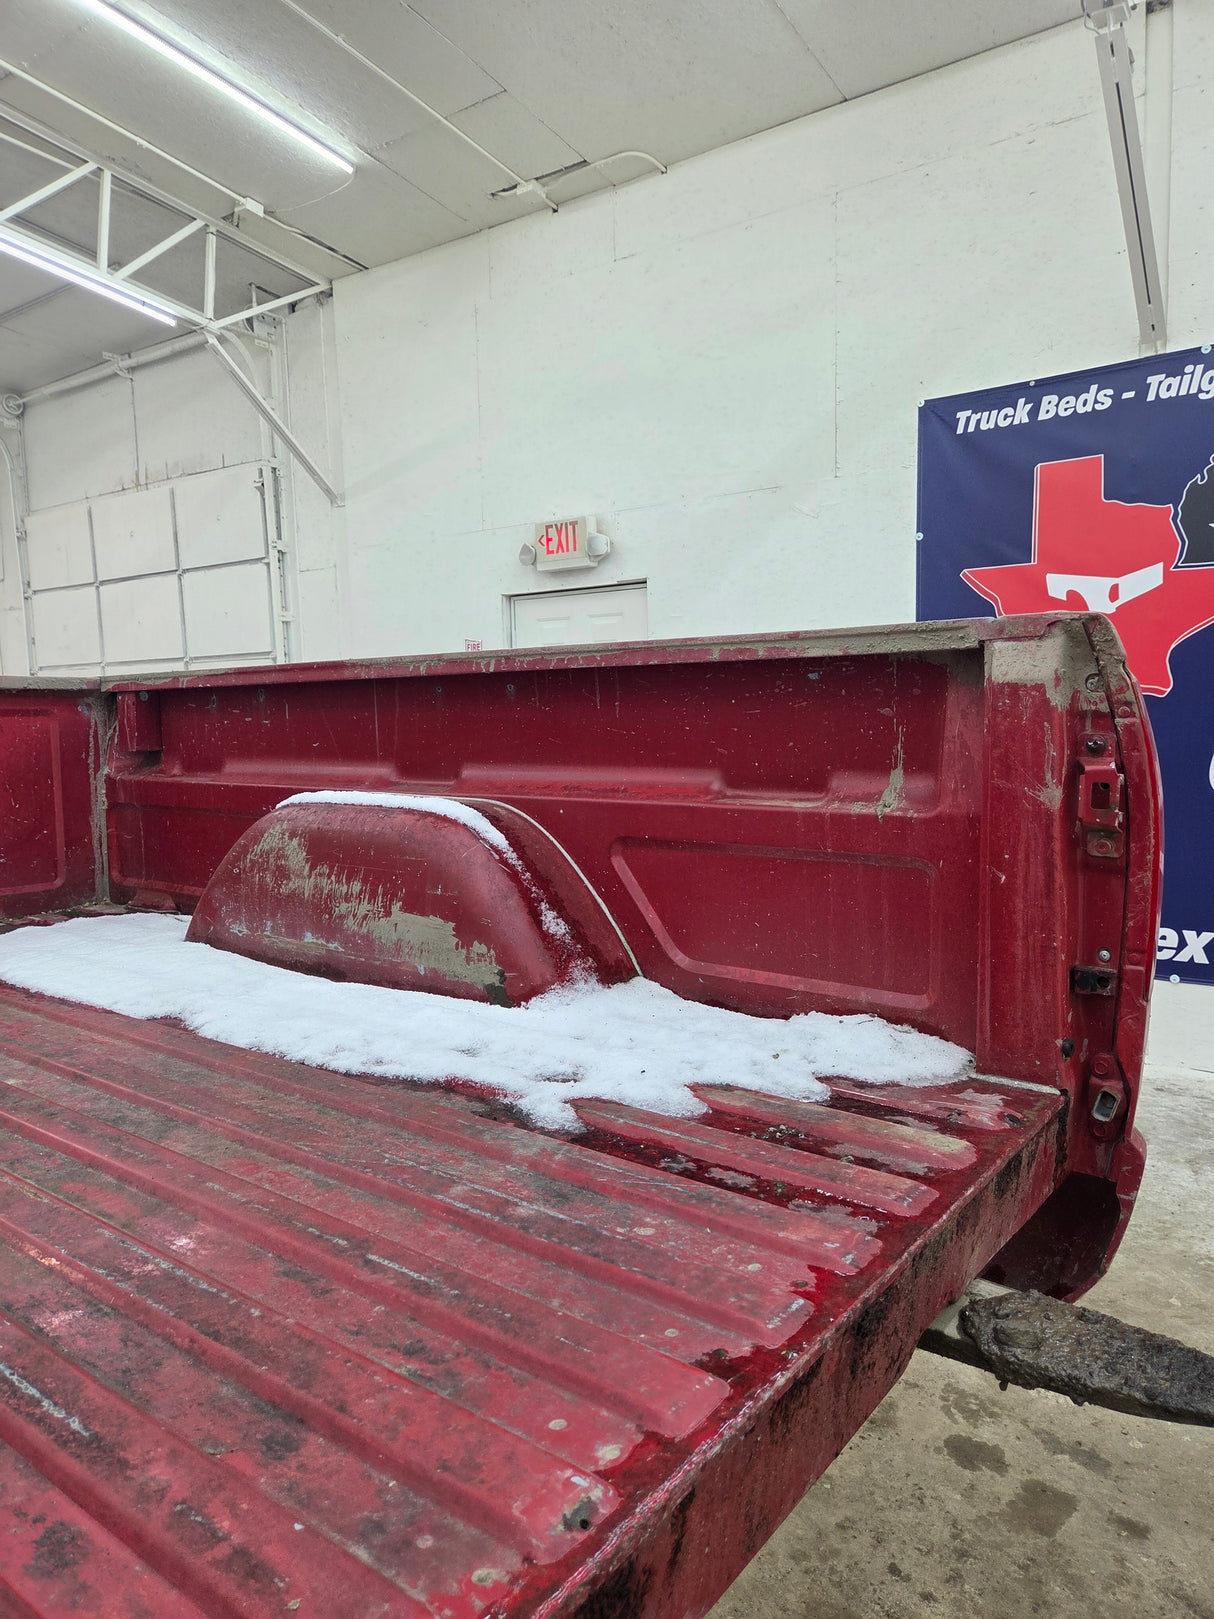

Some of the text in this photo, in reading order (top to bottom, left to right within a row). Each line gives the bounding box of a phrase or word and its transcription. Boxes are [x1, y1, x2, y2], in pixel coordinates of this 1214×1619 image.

[956, 398, 1033, 434] Truck
[1038, 384, 1114, 420] Beds
[1146, 364, 1214, 402] Tailg
[545, 521, 578, 555] EXIT
[467, 642, 481, 651] FIRE
